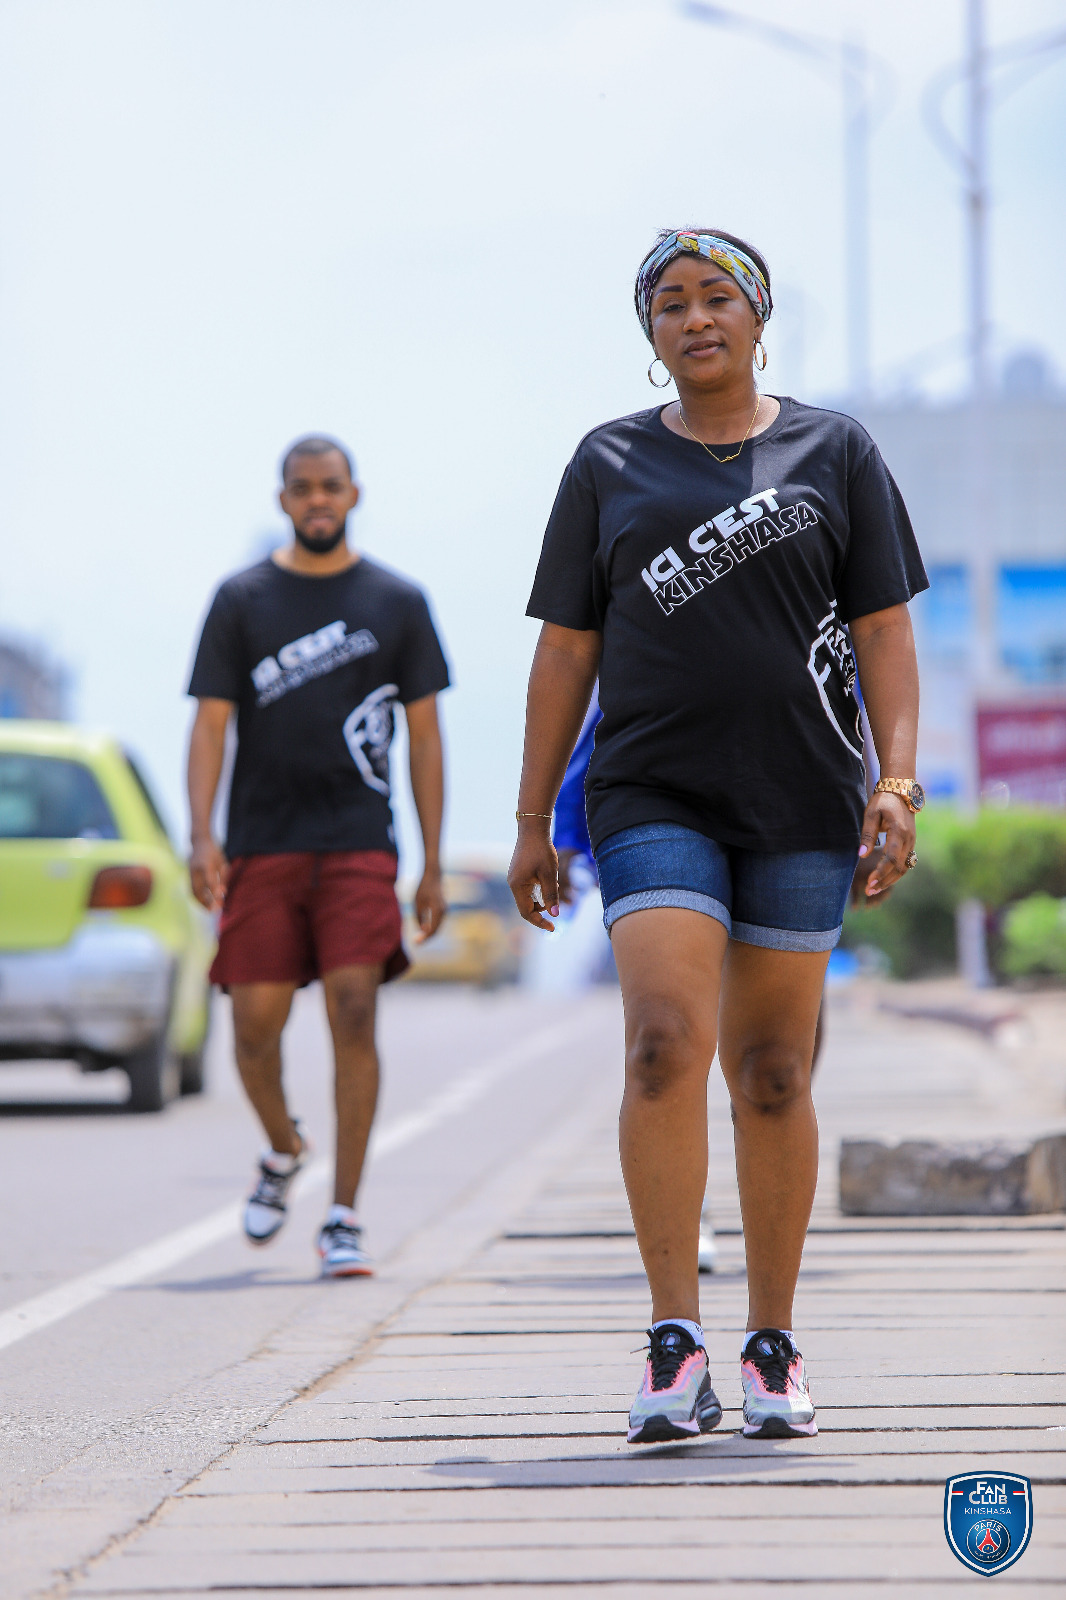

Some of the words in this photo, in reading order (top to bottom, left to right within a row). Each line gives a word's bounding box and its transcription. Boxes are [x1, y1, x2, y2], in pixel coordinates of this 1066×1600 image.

[641, 546, 686, 593] ICI
[688, 487, 780, 554] C'EST
[654, 501, 819, 616] KINSHASA
